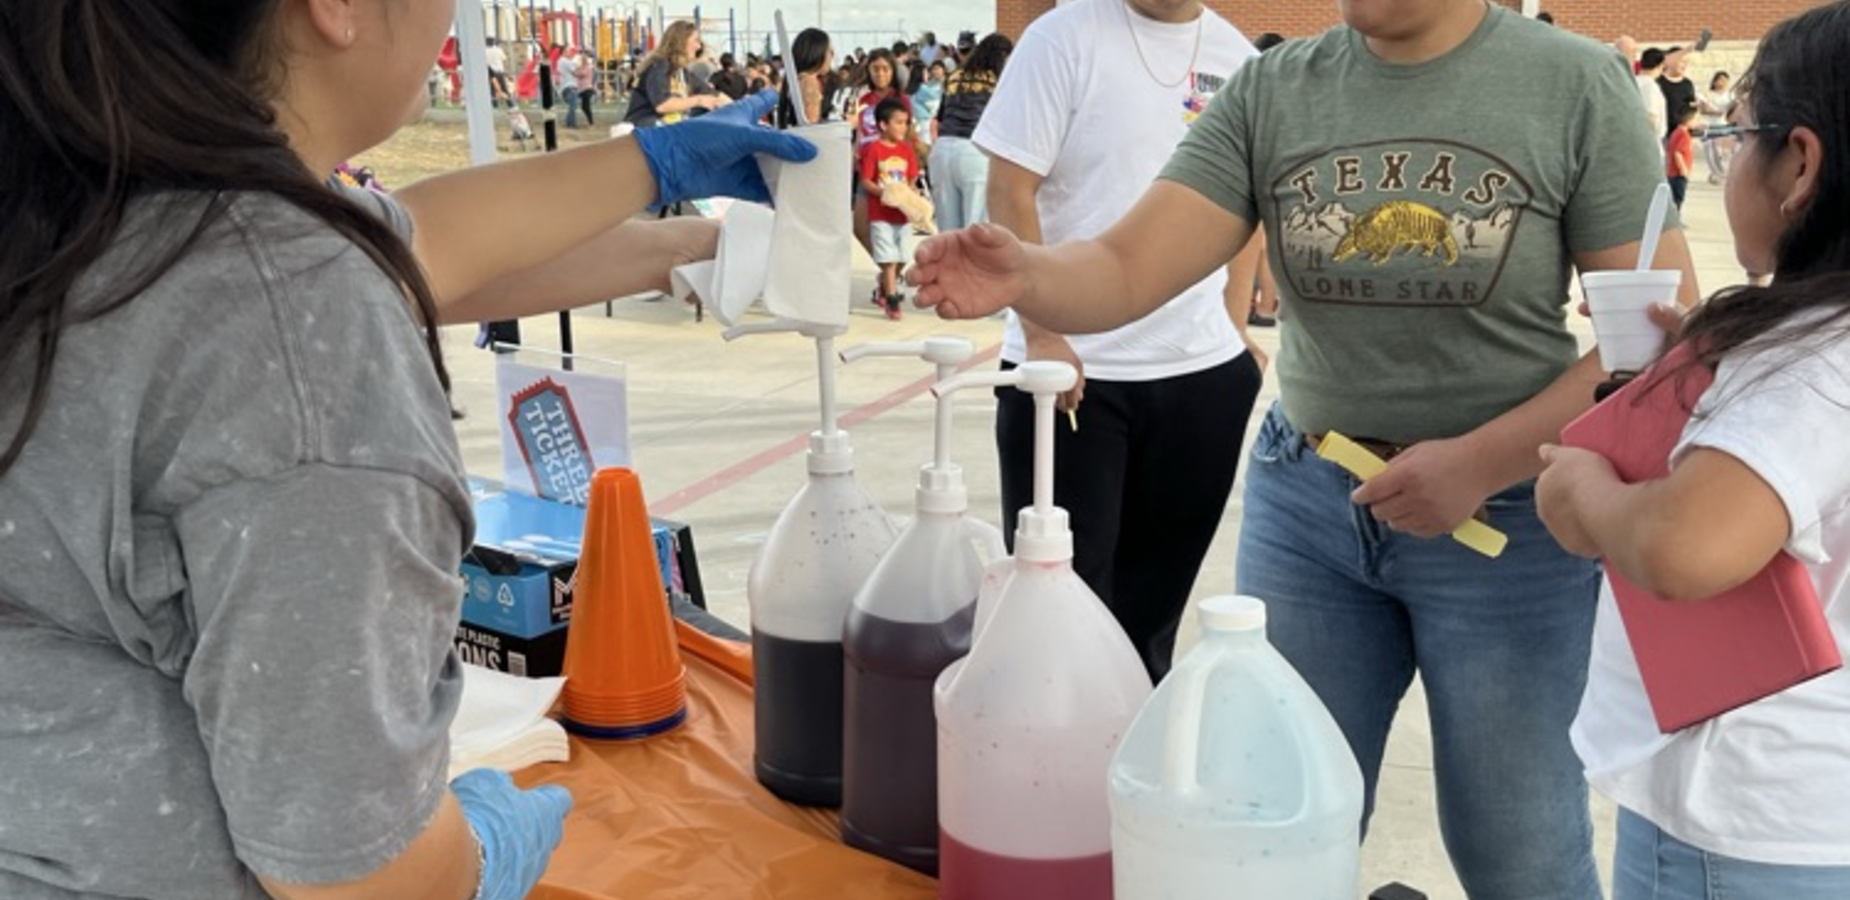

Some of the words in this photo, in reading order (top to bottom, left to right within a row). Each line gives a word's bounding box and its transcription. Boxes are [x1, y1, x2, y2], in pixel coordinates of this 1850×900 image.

[1292, 152, 1510, 207] TEXAS
[1300, 277, 1376, 297] LONE
[1397, 279, 1479, 301] STAR
